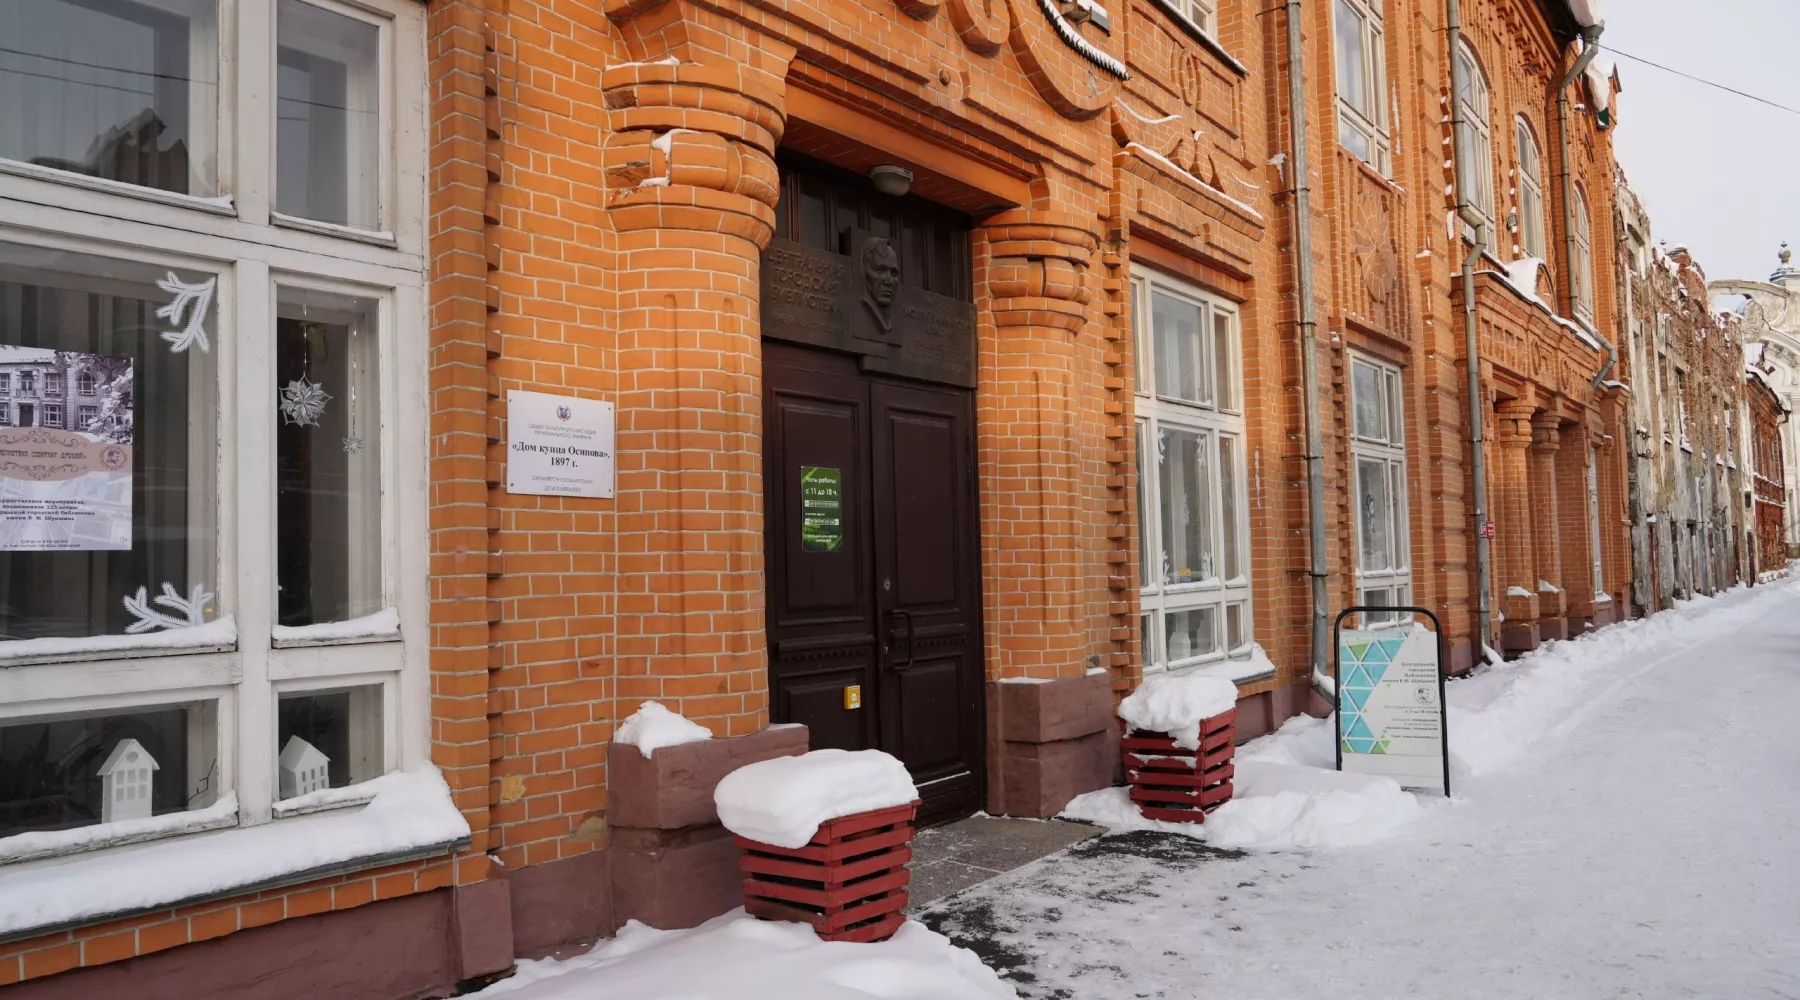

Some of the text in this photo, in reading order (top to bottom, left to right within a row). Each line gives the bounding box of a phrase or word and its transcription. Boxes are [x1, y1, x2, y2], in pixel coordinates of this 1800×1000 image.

[512, 442, 536, 452] «Дом
[540, 446, 566, 455] купца
[551, 457, 570, 466] 1897
